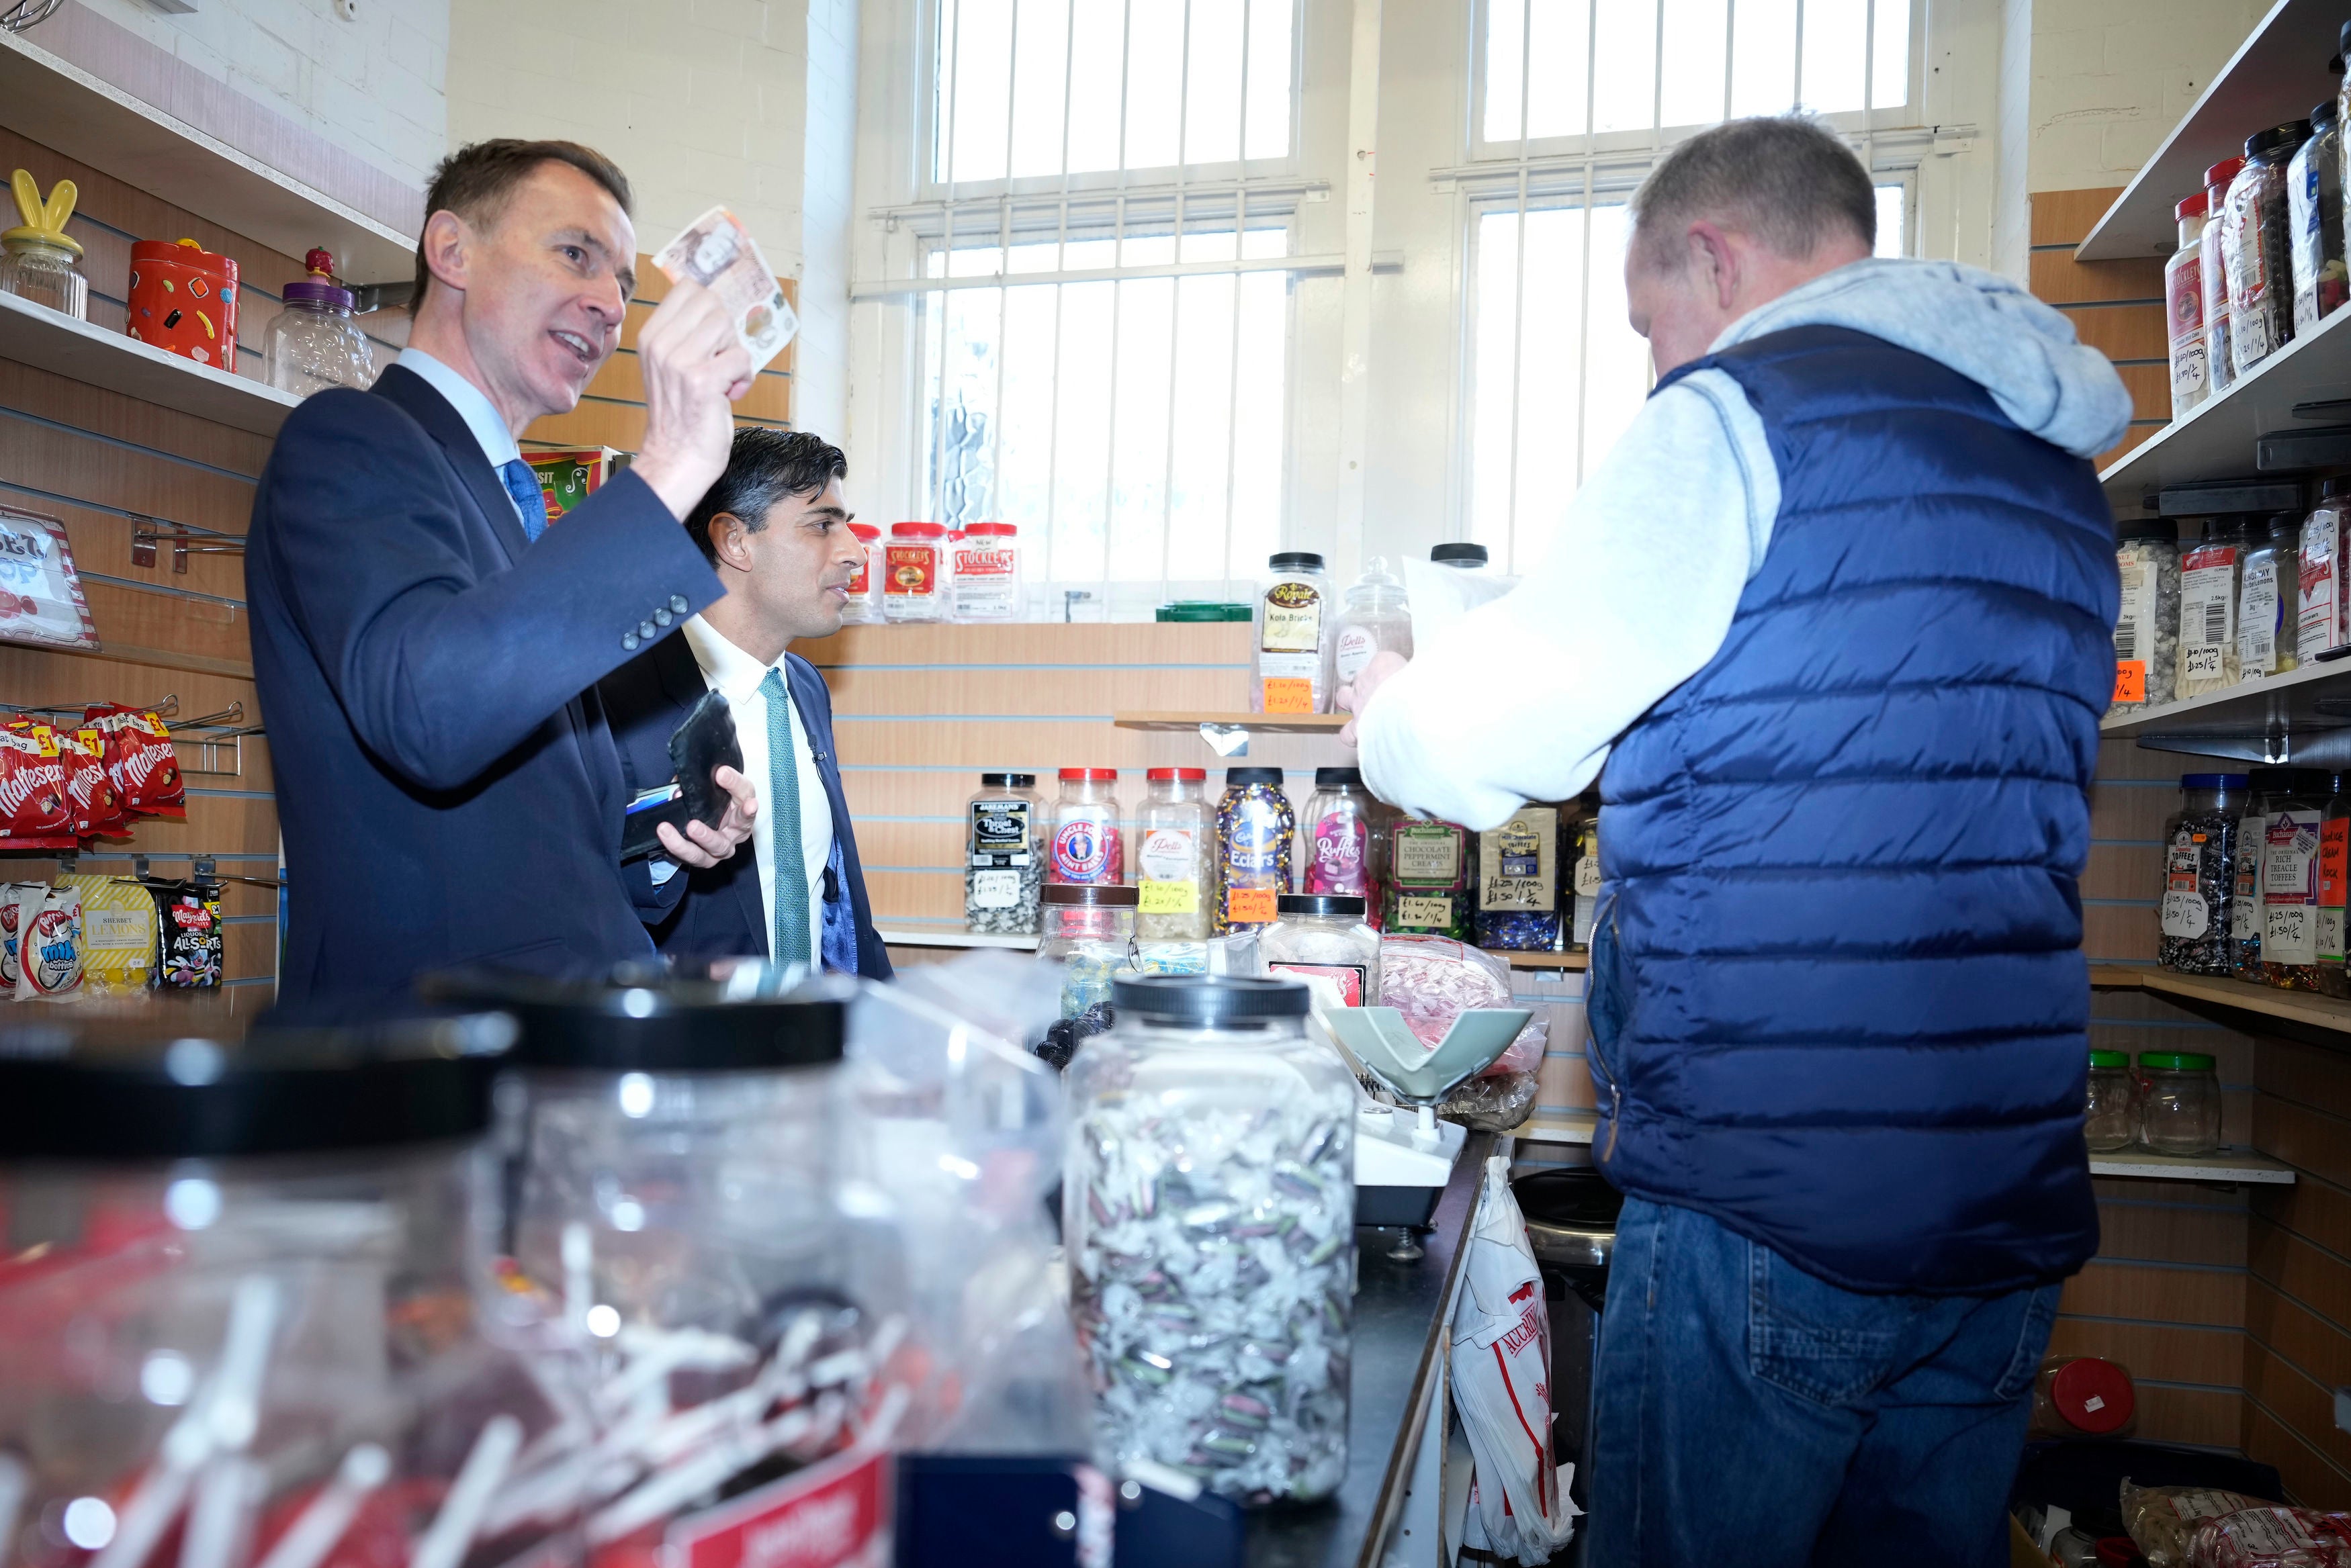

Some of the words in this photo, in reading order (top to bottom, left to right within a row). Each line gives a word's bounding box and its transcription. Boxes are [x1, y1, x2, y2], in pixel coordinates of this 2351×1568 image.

[1270, 614, 1286, 622] Kola
[132, 719, 144, 731] bag
[149, 717, 165, 731] £1
[11, 739, 28, 751] bag
[38, 734, 56, 751] £1
[83, 737, 99, 753] £1
[0, 764, 66, 818] Maltesers
[1059, 823, 1083, 844] UNCLE
[1317, 837, 1360, 863] Ruffles
[2172, 852, 2194, 862] TOFFEES
[1059, 853, 1081, 871] MINT
[1081, 851, 1104, 871] BALLS
[1231, 850, 1274, 868] Eclars
[2270, 864, 2297, 872] TREACLE
[2271, 874, 2296, 882] TOFFEES
[92, 923, 146, 935] LEMONS
[173, 937, 221, 952] ALLSORTS
